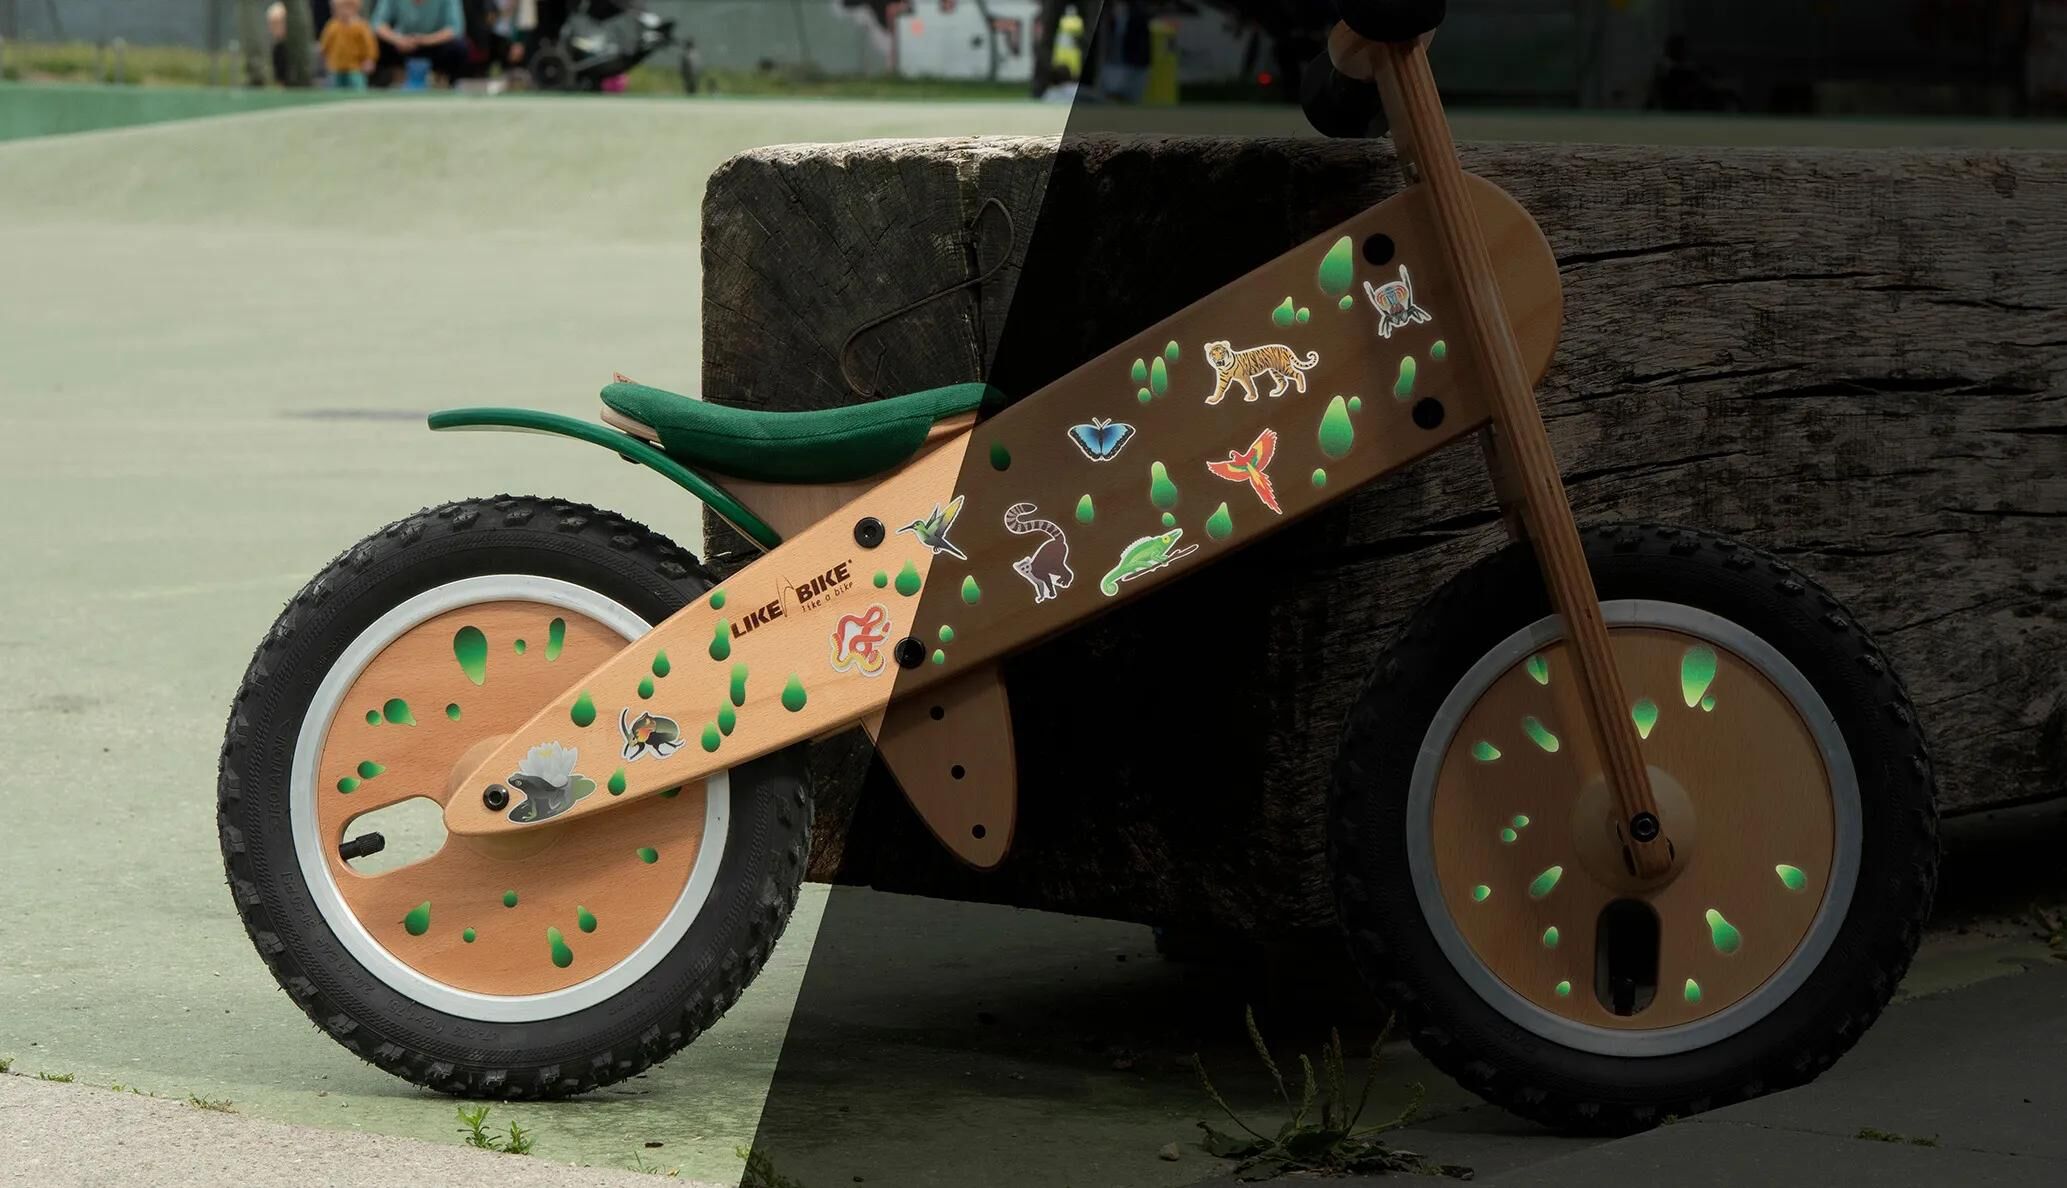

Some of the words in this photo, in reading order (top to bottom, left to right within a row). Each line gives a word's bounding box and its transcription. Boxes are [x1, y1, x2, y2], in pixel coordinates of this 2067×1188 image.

[730, 600, 783, 639] LIKE
[795, 562, 850, 604] BIKE
[801, 599, 822, 613] like
[834, 581, 853, 597] bike
